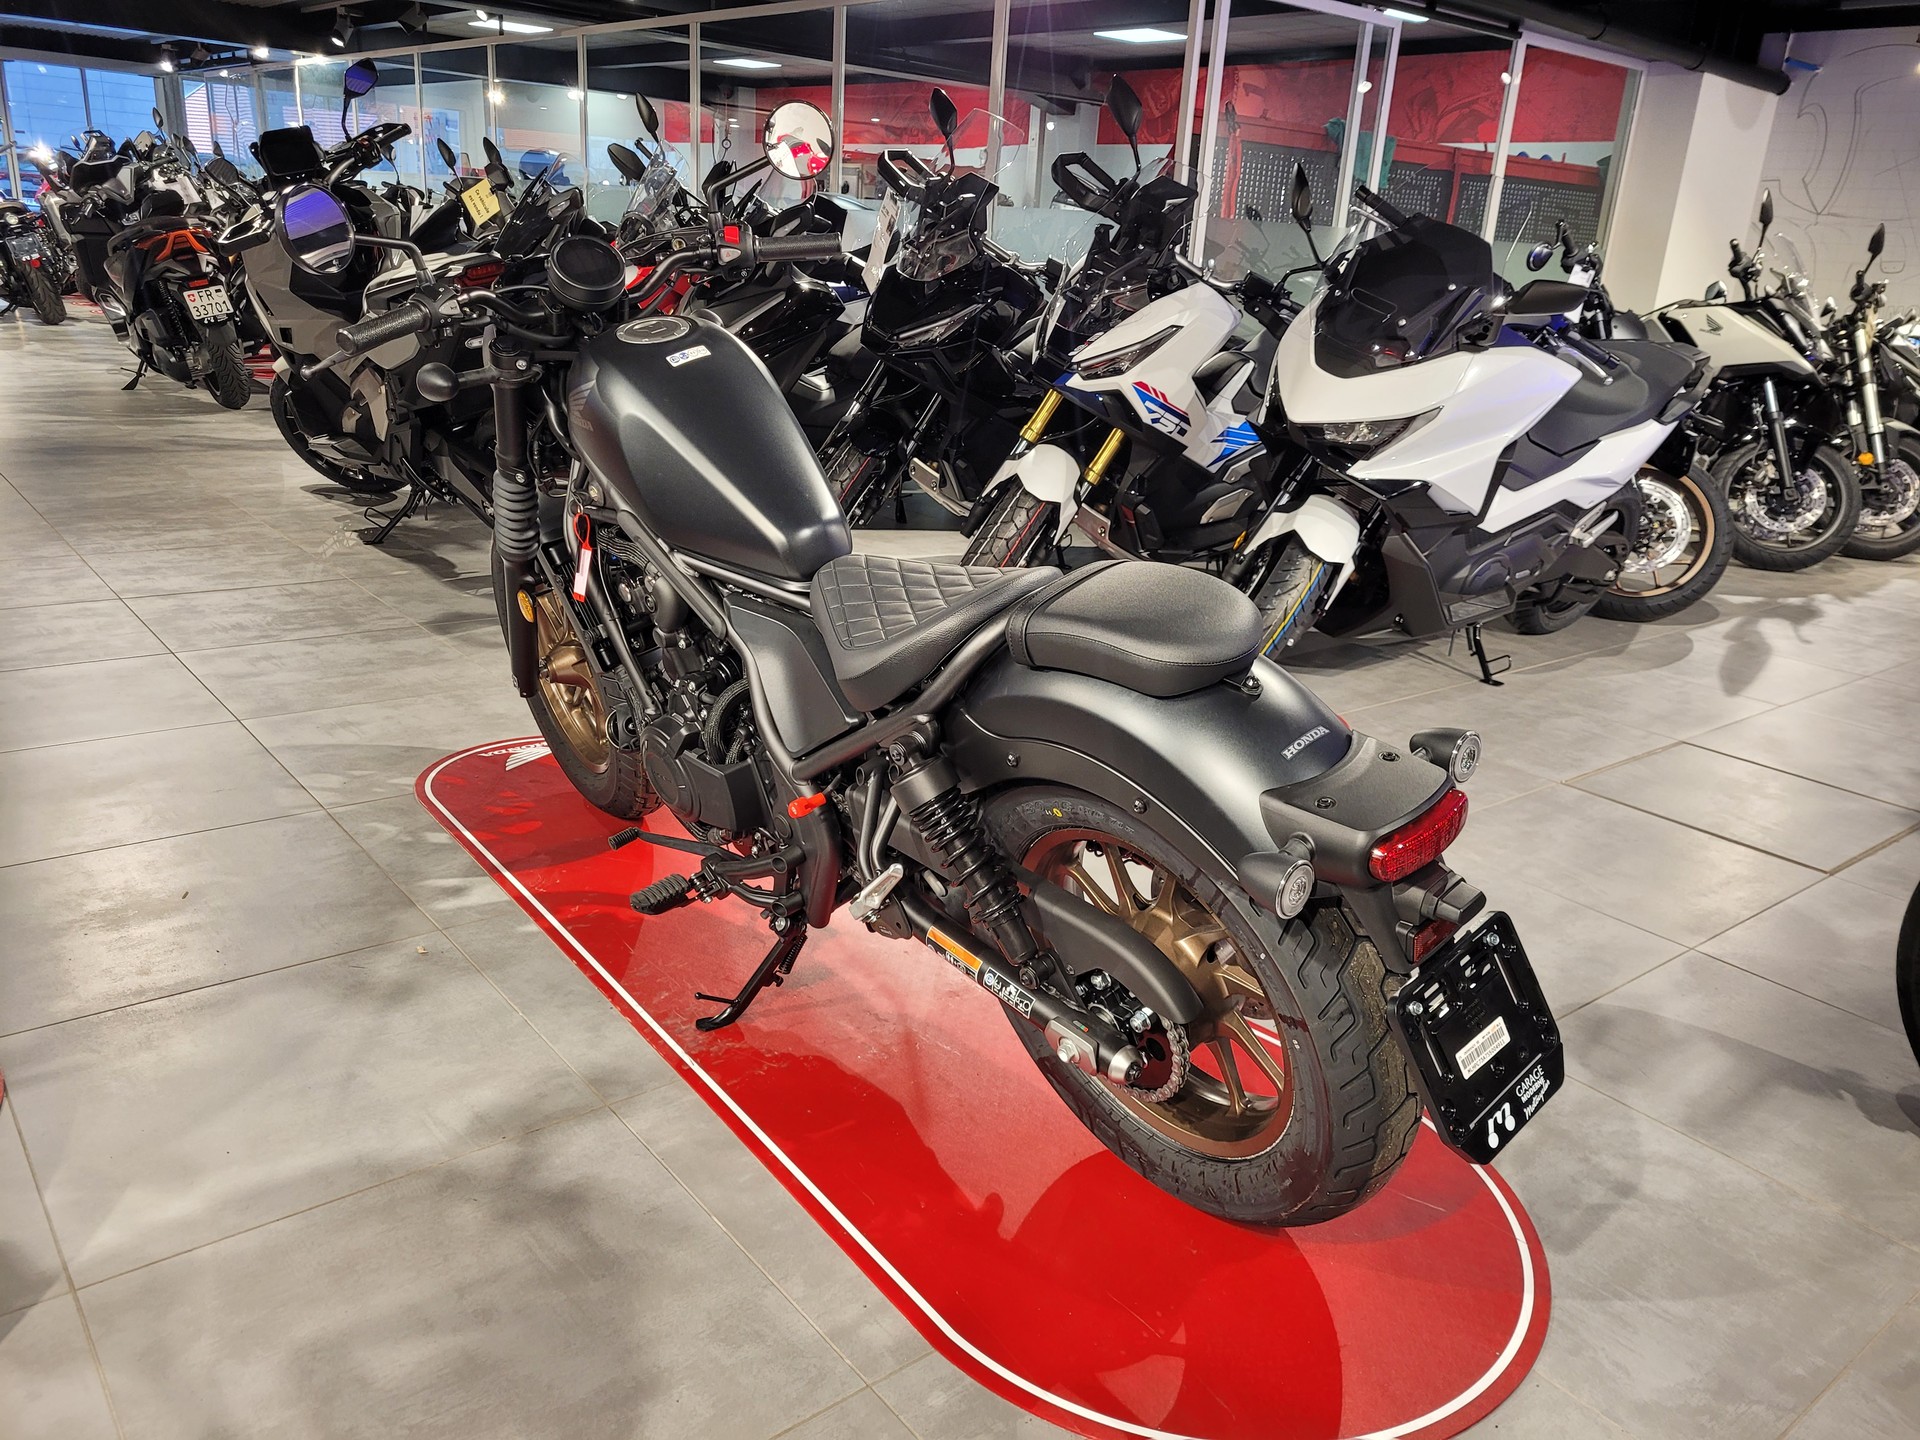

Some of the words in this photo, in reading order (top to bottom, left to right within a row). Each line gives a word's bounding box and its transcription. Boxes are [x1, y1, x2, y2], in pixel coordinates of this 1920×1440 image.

[192, 300, 231, 317] 33701
[197, 290, 215, 302] FR
[1282, 726, 1331, 759] HONDA
[1515, 1064, 1545, 1097] GARAGE
[1520, 1076, 1546, 1104] MODERNE
